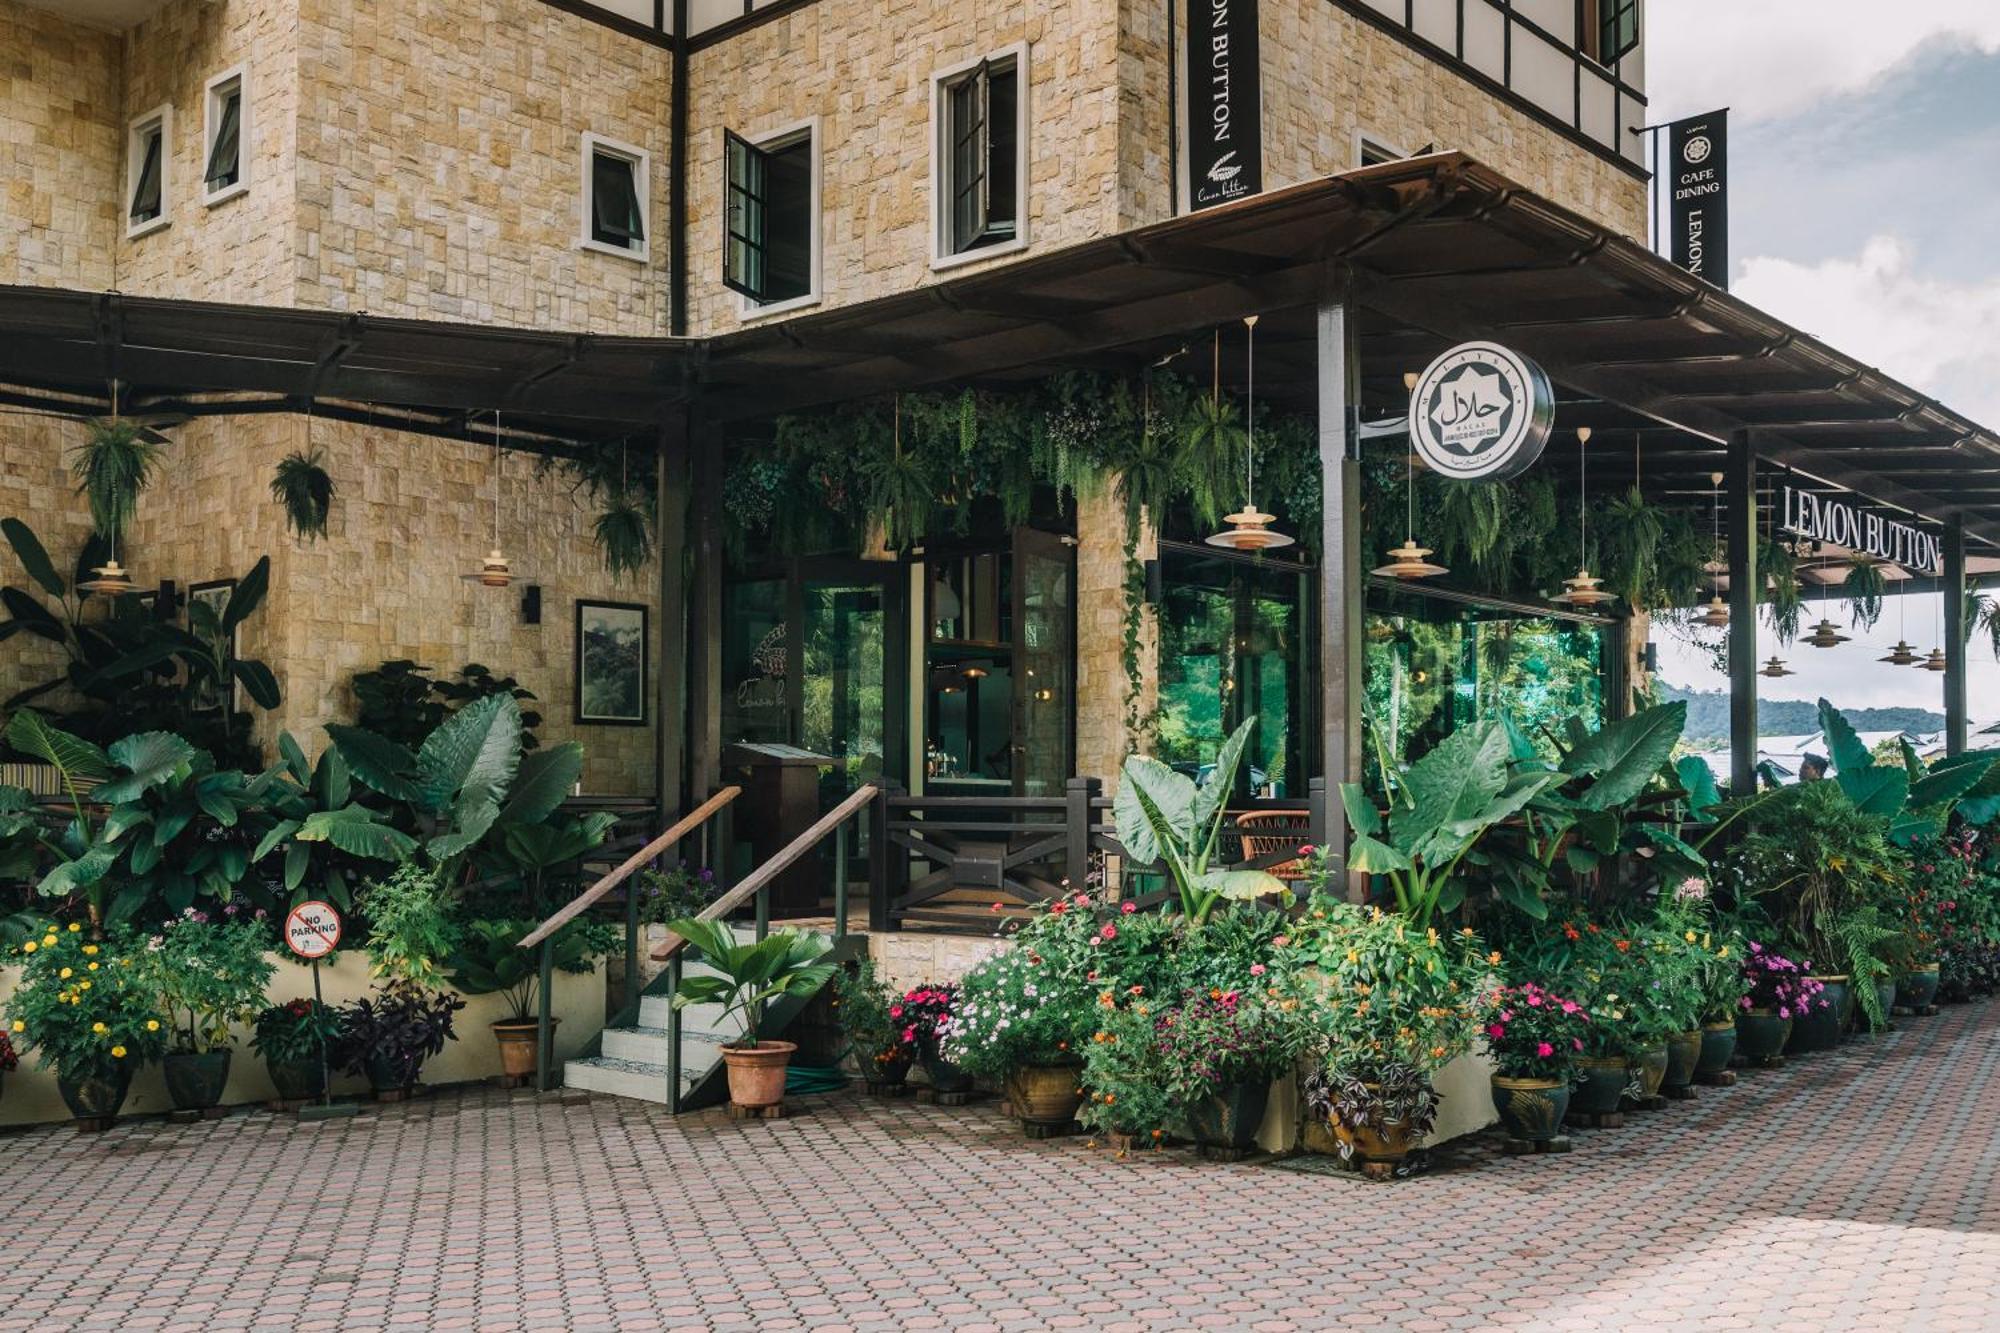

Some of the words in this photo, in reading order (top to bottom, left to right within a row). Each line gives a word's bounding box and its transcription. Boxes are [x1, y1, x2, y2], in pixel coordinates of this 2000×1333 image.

[1212, 33, 1230, 141] BUTTON
[1681, 168, 1714, 184] CAFE
[1676, 182, 1720, 200] DINING
[1688, 209, 1703, 273] LEMON
[1441, 389, 1500, 425] حلال
[1784, 486, 1861, 549] LEMON
[1866, 513, 1941, 573] BUTTON
[291, 923, 337, 937] PARKING
[305, 915, 321, 925] NO
